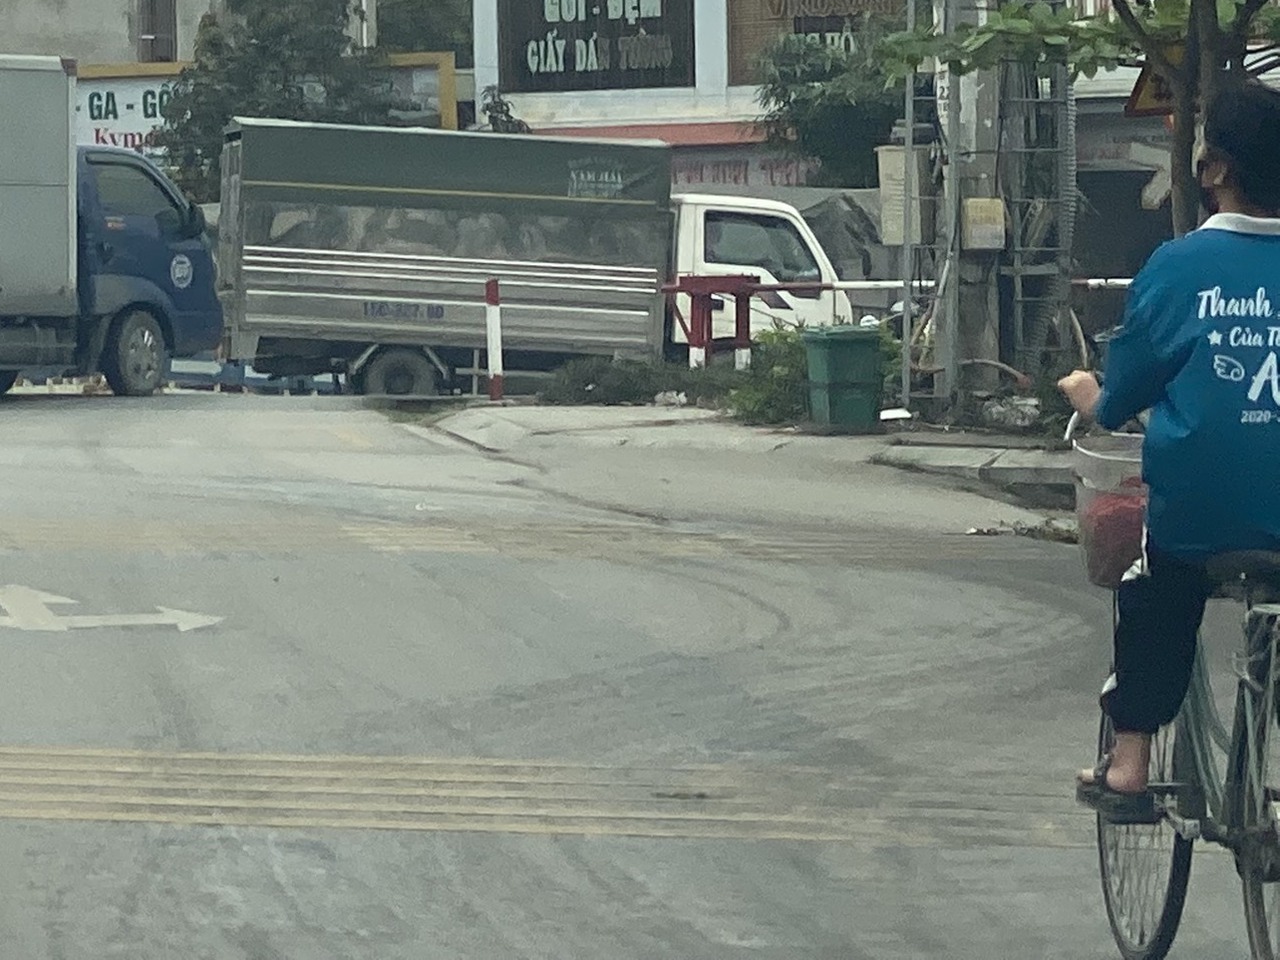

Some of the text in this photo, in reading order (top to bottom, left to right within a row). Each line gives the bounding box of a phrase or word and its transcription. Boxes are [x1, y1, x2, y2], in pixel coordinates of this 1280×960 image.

[88, 91, 118, 120] GA
[1197, 286, 1272, 319] Thanh
[1229, 326, 1264, 347] Của
